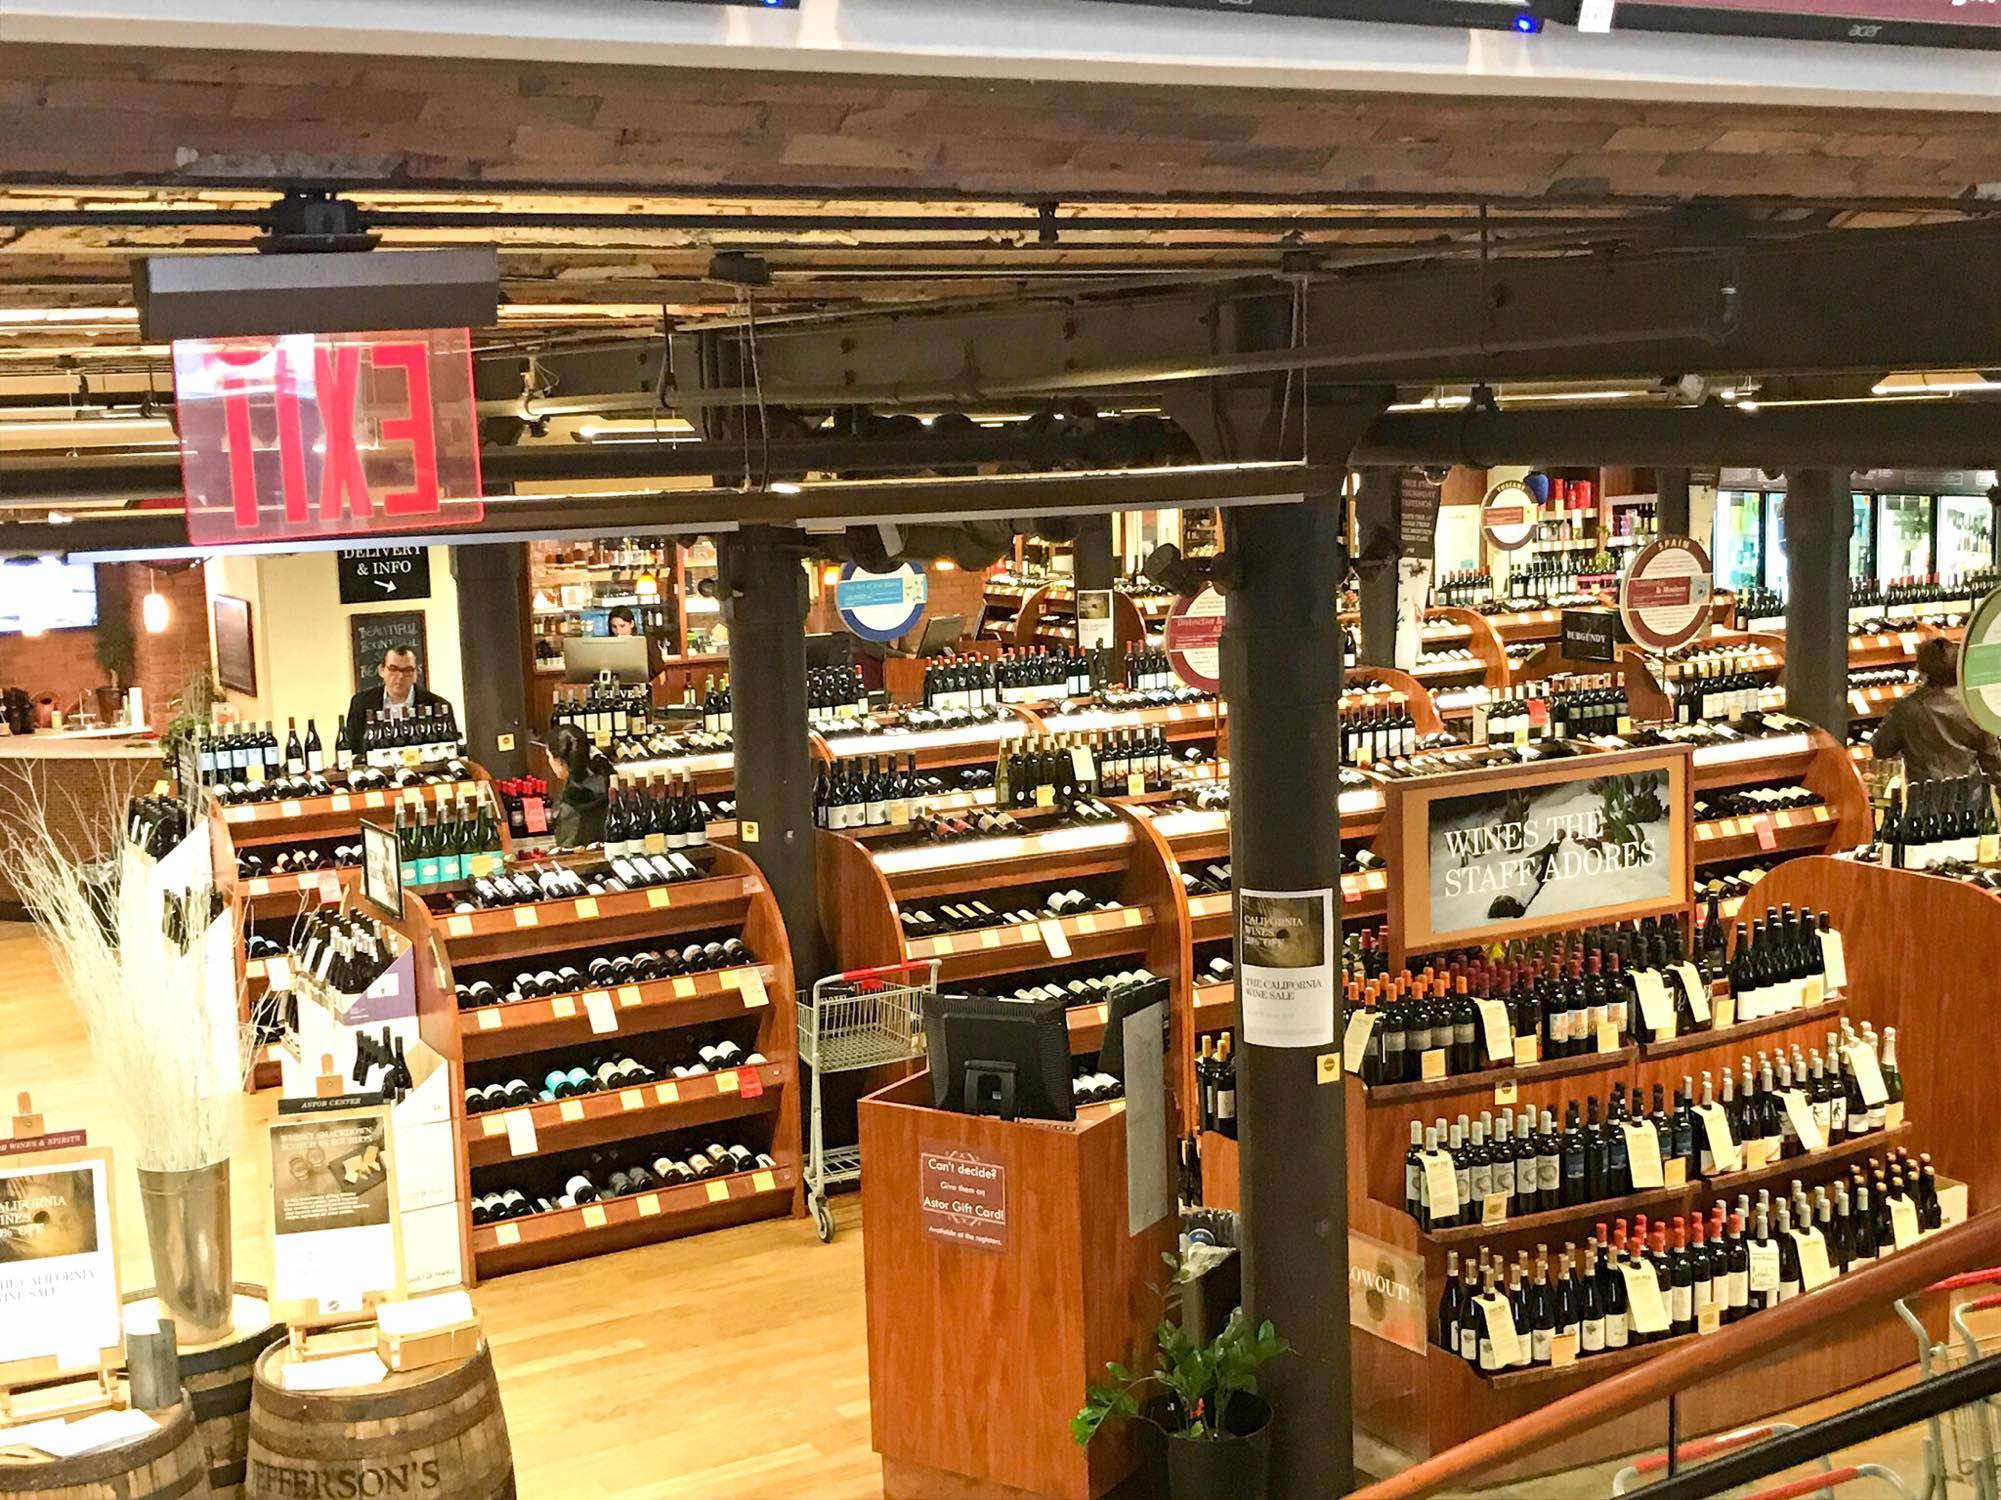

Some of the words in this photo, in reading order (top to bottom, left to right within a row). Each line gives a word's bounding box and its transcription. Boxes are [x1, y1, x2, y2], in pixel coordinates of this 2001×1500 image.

[1848, 24, 1883, 38] acer
[1658, 538, 1690, 550] SPAIN
[343, 545, 421, 559] DELIVERY
[356, 563, 369, 575] &
[373, 560, 412, 575] INFO
[1444, 819, 1539, 858] WINES
[1547, 808, 1607, 843] THE
[1444, 857, 1536, 897] STAFF
[1541, 839, 1657, 883] ADORES
[1243, 914, 1304, 927] CALIFORNIA
[1245, 977, 1263, 988] THE
[1263, 979, 1322, 990] CALIFORNIA
[1246, 988, 1268, 1000] WINE
[1269, 991, 1295, 1001] SALE
[329, 1097, 361, 1106] CENTER
[9, 1141, 37, 1150] WINES
[38, 1139, 45, 1147] &
[47, 1135, 81, 1146] SPIRITS
[928, 1158, 955, 1173] Can't
[957, 1163, 997, 1180] decide?
[940, 1181, 957, 1191] Give
[958, 1184, 975, 1194] them
[924, 1196, 949, 1210] Astor
[952, 1200, 972, 1214] Gift
[975, 1205, 1004, 1220] Card!
[1349, 1265, 1410, 1304] OWOUT!
[253, 1459, 441, 1499] EFFERSON'S
